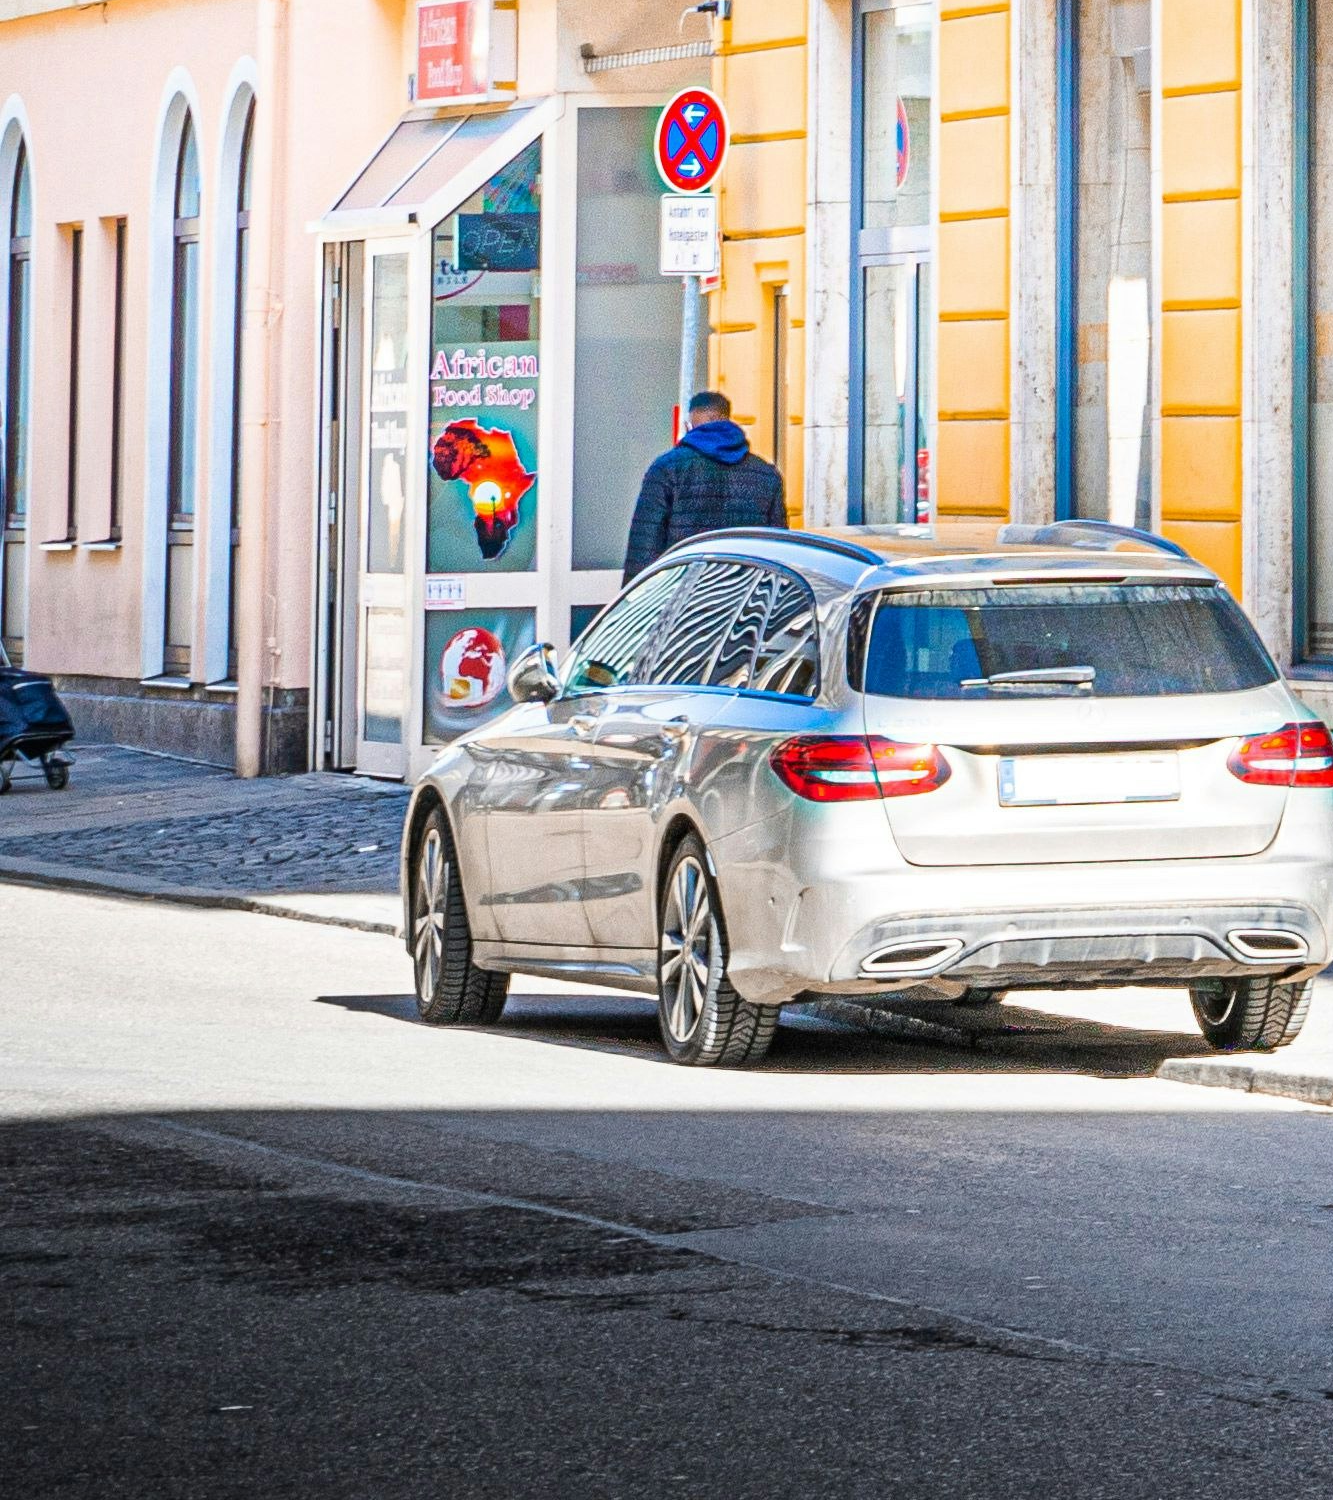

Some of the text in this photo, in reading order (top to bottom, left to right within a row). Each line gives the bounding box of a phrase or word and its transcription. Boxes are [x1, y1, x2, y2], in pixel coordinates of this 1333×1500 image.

[430, 350, 539, 380] African
[432, 384, 483, 407] Food
[484, 383, 536, 410] Shop
